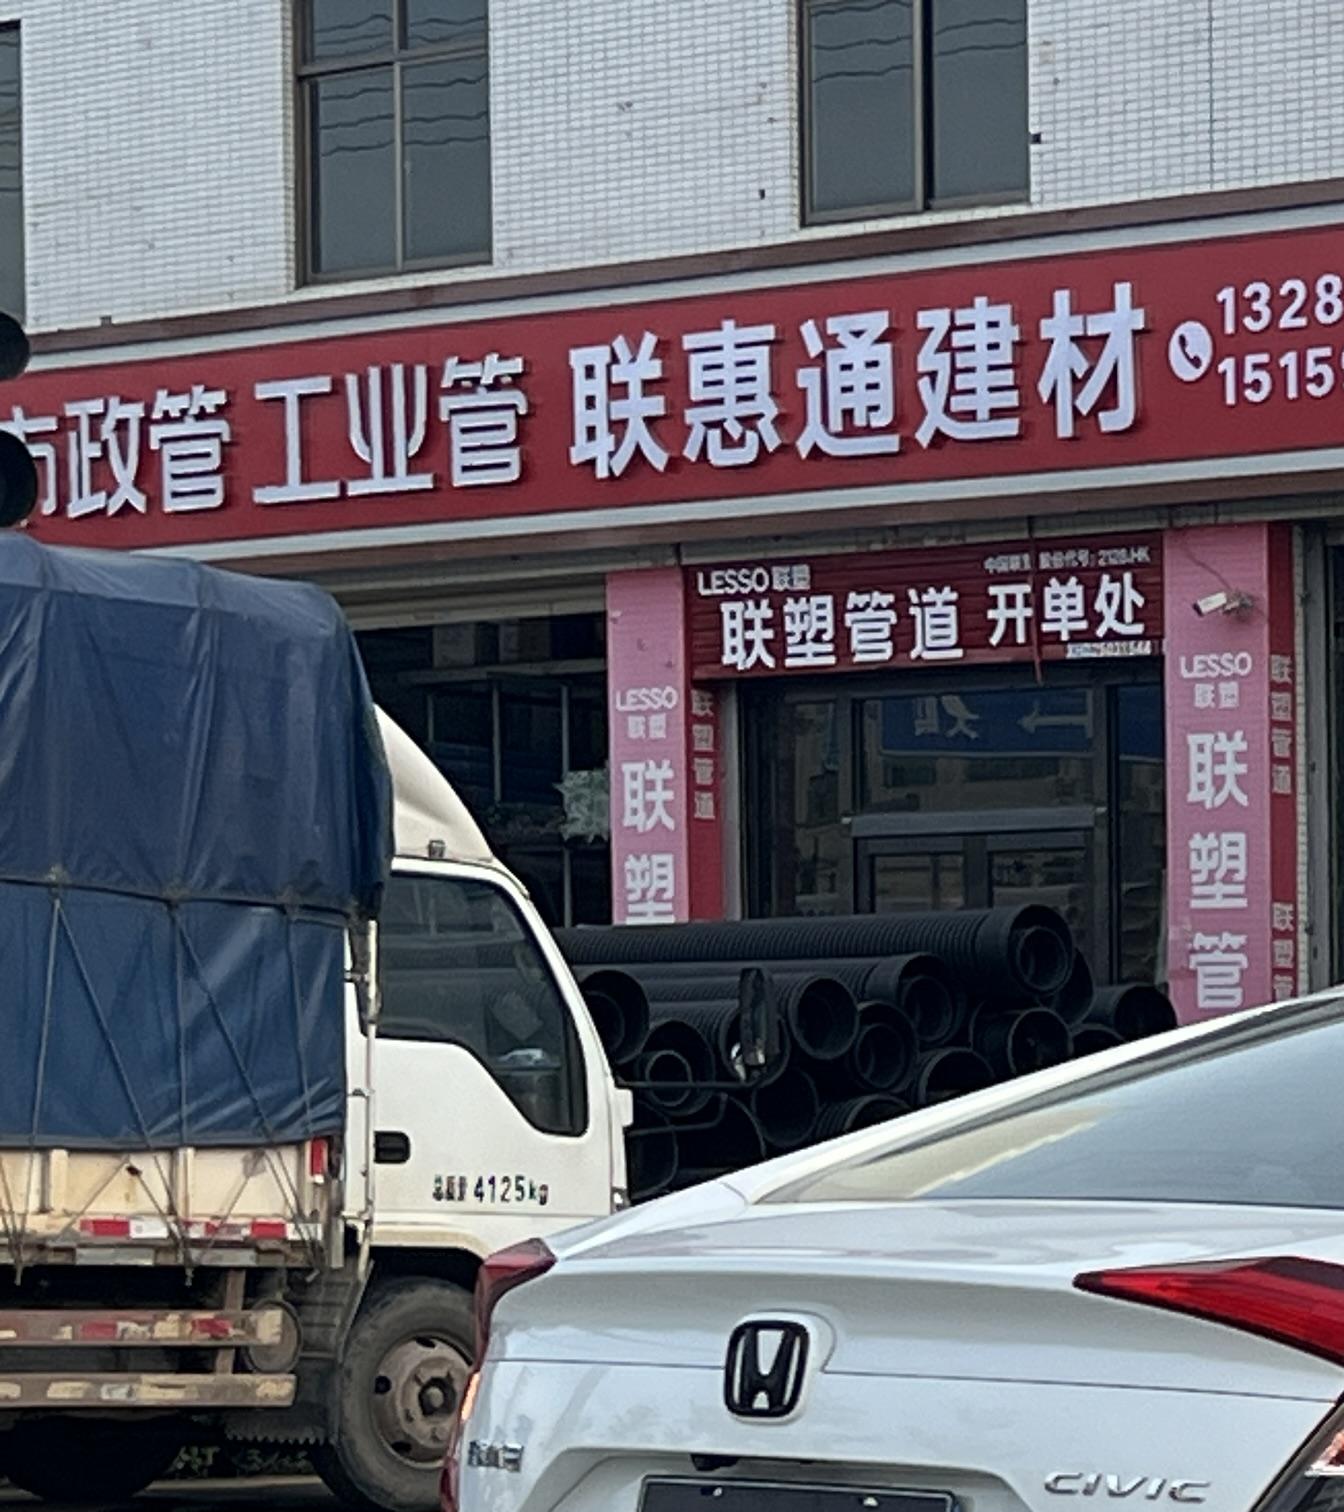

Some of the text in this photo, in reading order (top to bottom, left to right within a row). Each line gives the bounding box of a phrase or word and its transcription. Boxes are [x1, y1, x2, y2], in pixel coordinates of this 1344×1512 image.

[253, 353, 530, 505] 工业管
[568, 281, 1149, 479] 联惠通建材
[698, 567, 770, 595] LESSO
[720, 571, 1146, 671] 联塑管道 开单处
[1180, 652, 1253, 680] LESSO
[616, 686, 678, 712] LESSO
[621, 760, 676, 925] 联塑
[1187, 731, 1249, 1009] 联塑管
[473, 1175, 549, 1206] 4125kg
[1044, 1472, 1212, 1504] CIVIC
